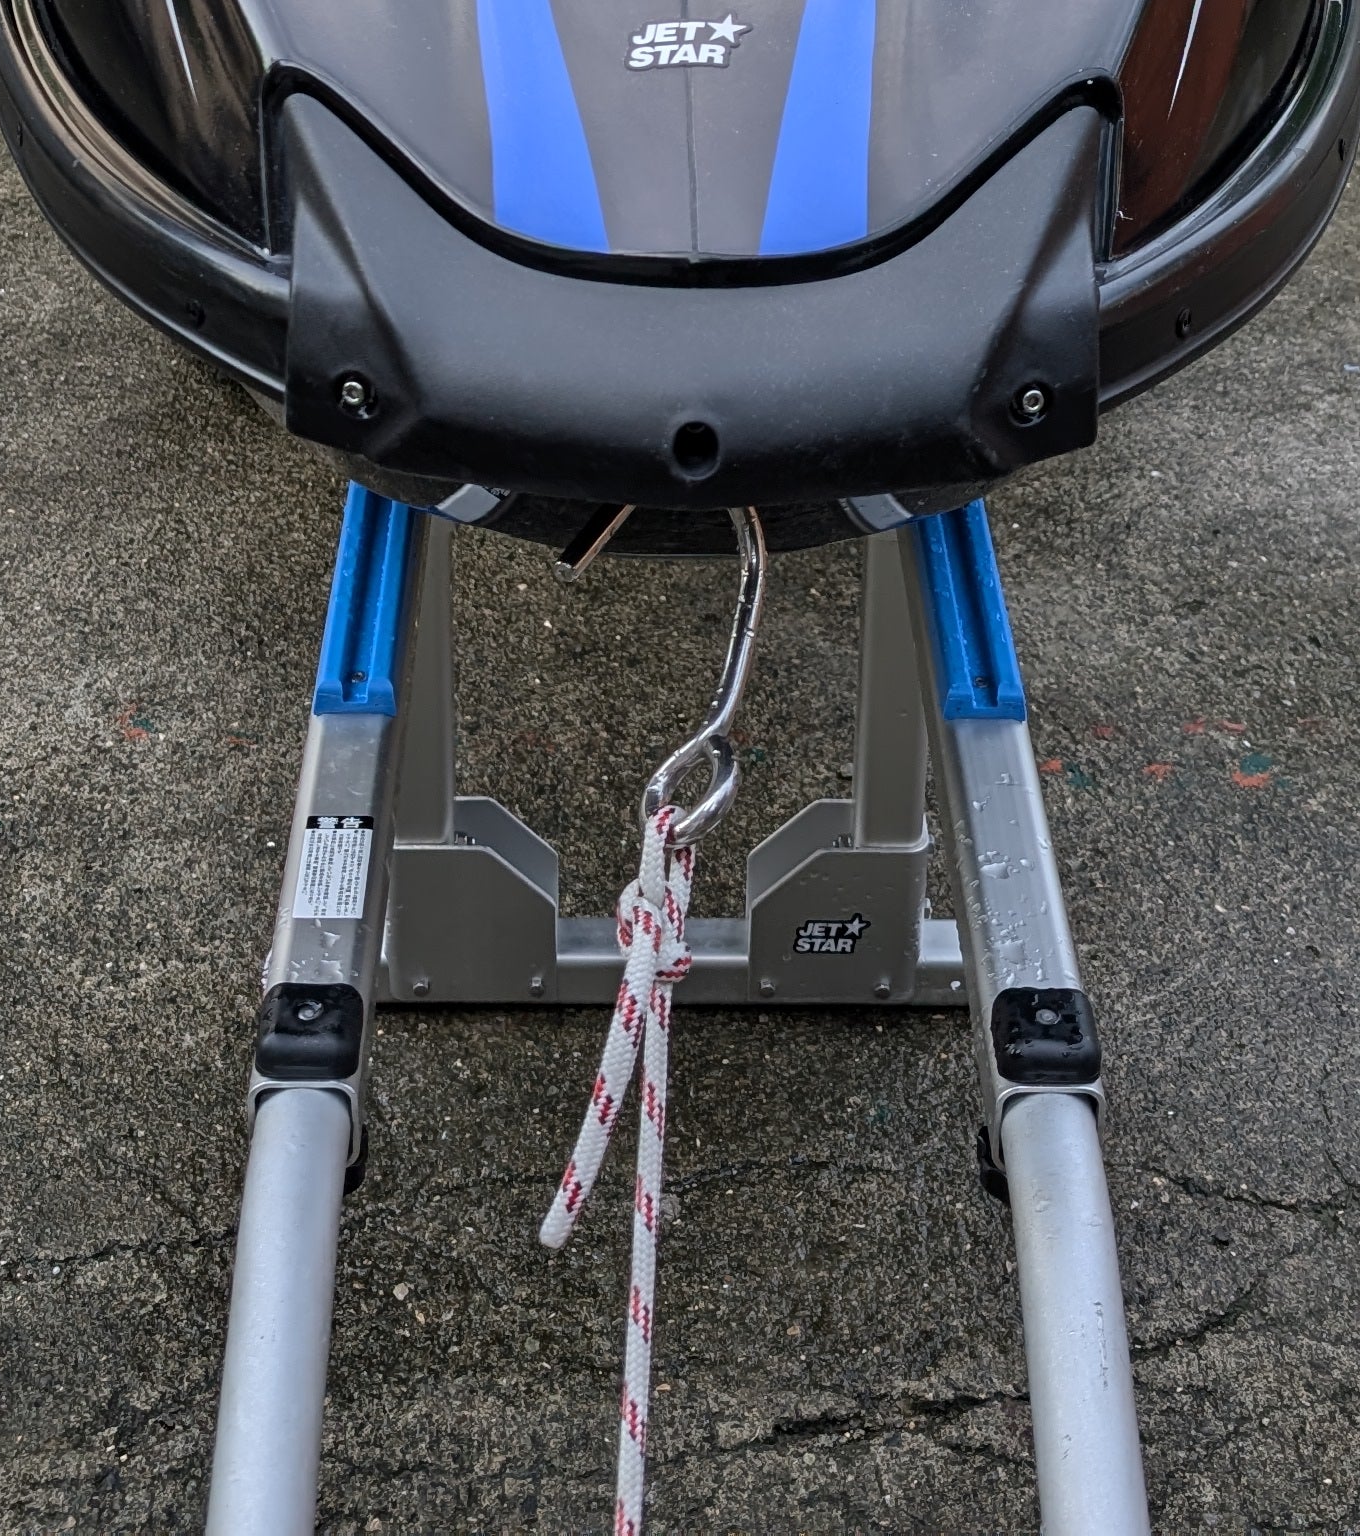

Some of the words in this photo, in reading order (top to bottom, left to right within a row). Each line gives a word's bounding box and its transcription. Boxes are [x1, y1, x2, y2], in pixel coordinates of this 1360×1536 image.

[633, 21, 706, 44] JET
[629, 45, 725, 65] STAR
[799, 922, 843, 937] JET
[796, 938, 853, 952] STAR
